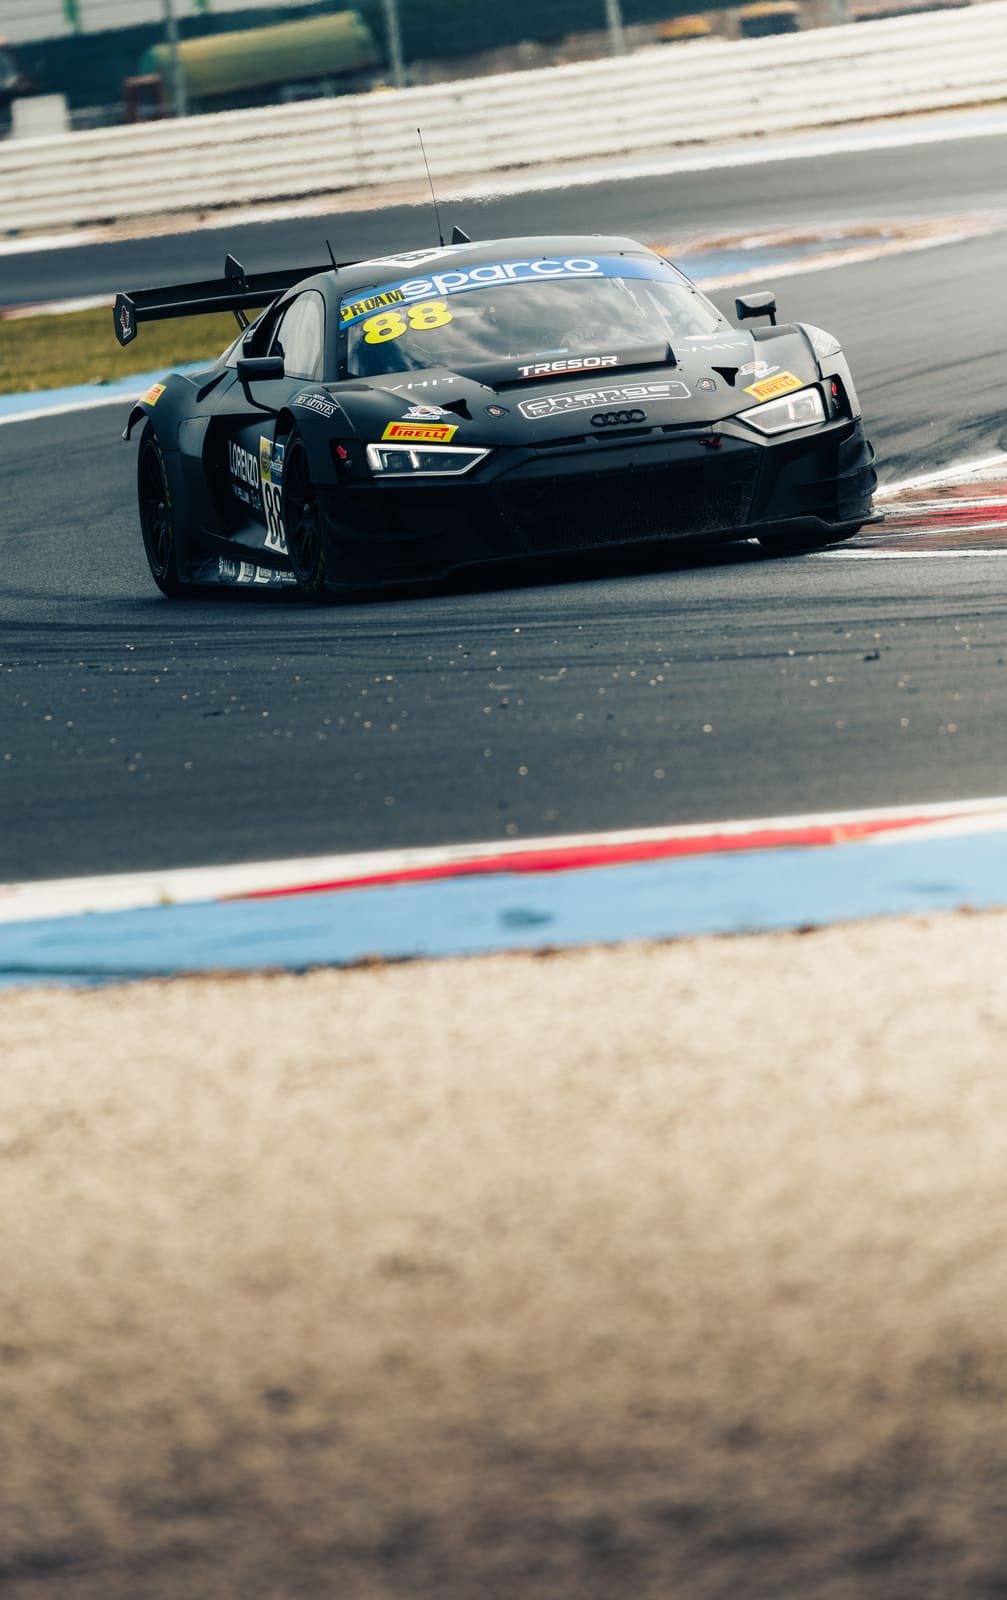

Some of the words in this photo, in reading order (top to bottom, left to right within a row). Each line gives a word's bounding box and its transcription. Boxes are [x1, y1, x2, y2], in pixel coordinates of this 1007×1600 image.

[401, 259, 599, 296] sparco
[363, 302, 453, 345] 88
[518, 355, 618, 377] TRESOR
[526, 385, 671, 411] change
[752, 375, 796, 397] PIRELLI
[389, 425, 450, 439] PIRELLI
[228, 440, 259, 489] LORENZO
